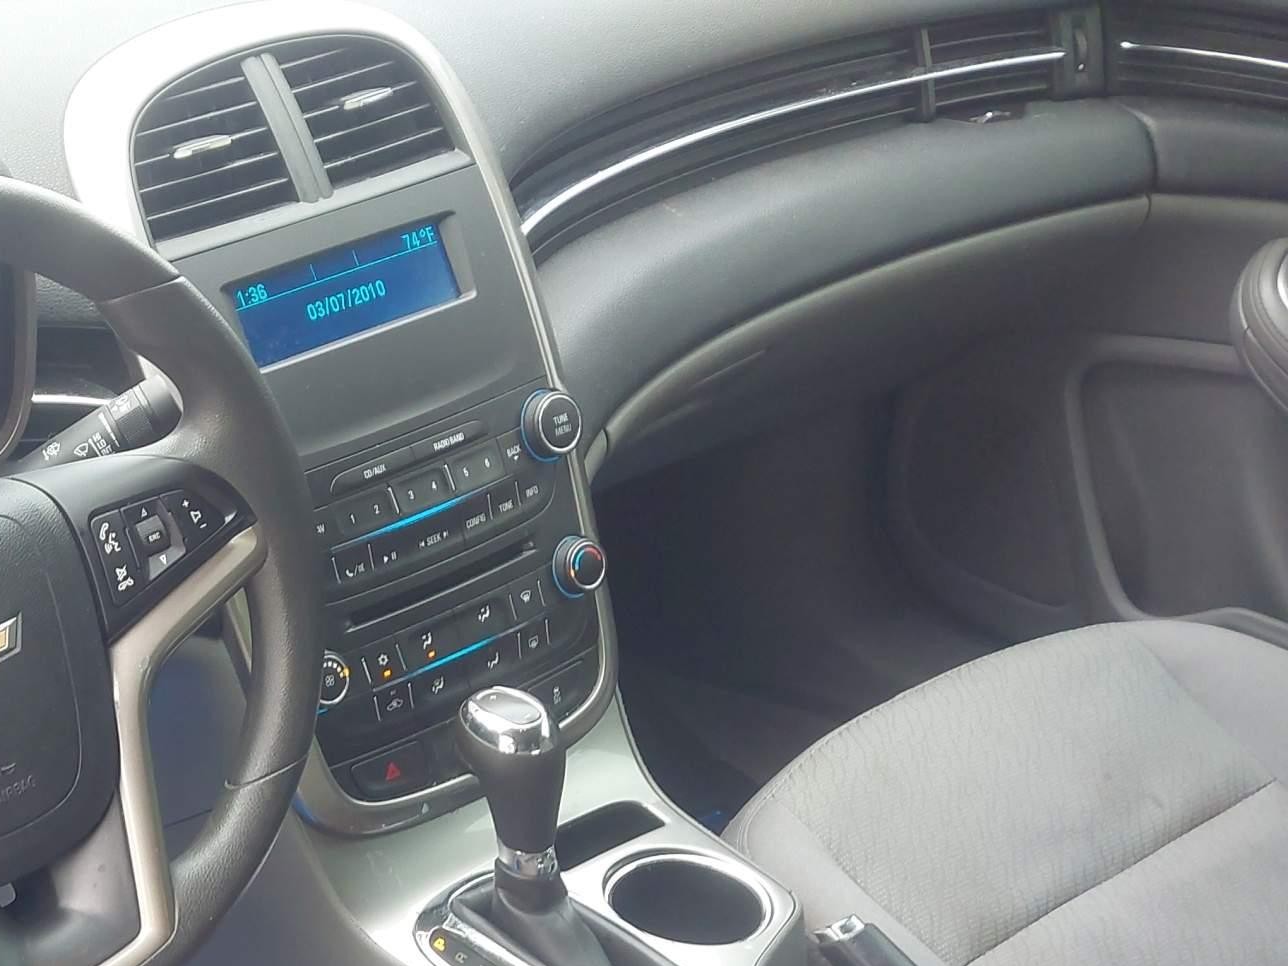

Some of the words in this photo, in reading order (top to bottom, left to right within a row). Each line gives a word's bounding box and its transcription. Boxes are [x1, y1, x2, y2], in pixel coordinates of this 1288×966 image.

[401, 226, 435, 250] 74°F
[236, 283, 268, 307] 1:36
[307, 279, 387, 321] 03/07/2010
[553, 412, 569, 425] TUNE
[427, 533, 441, 546] SEEK
[433, 938, 446, 951] P
